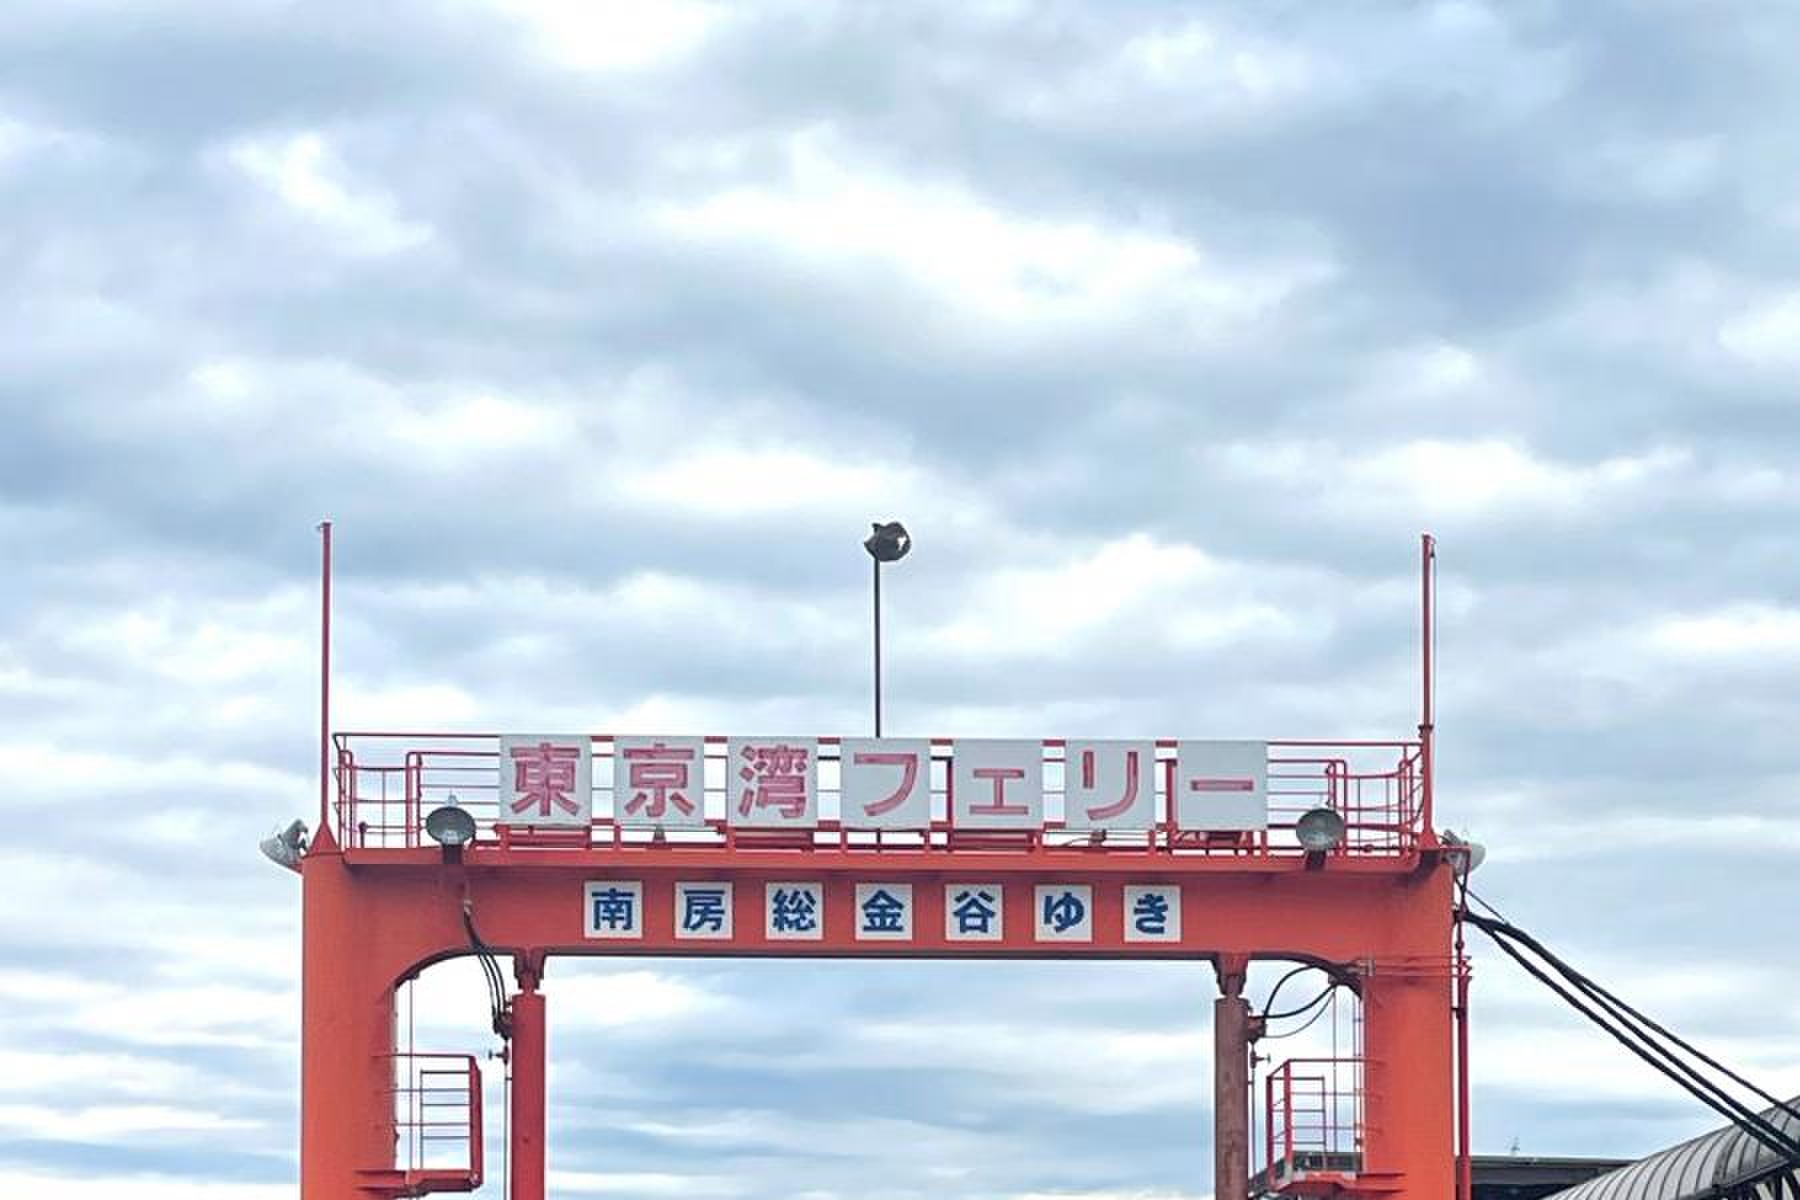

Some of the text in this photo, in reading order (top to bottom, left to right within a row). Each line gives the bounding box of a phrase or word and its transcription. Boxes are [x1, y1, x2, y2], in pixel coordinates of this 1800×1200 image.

[509, 742, 1255, 820] 東京湾フェリー
[591, 889, 1170, 935] 南房総金谷ゆき
